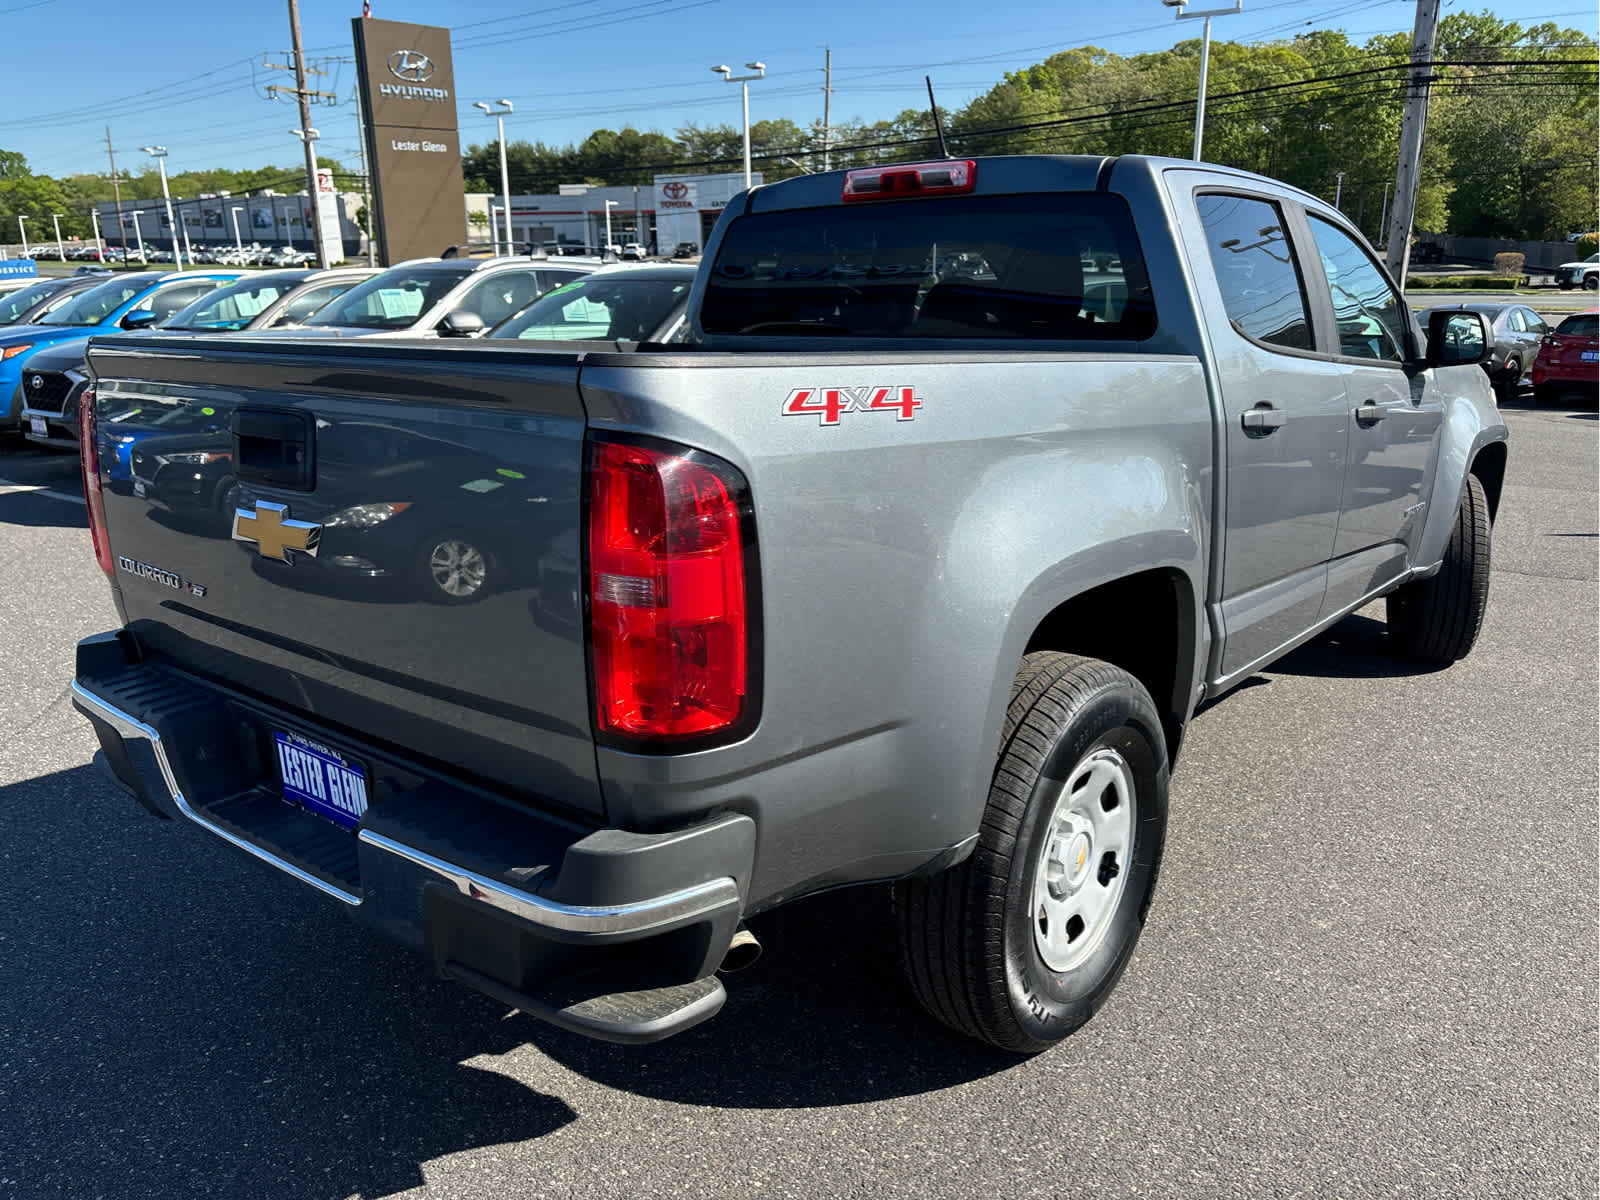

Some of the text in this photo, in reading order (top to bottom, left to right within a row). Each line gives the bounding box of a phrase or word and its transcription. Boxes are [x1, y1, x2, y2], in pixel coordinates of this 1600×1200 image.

[379, 83, 449, 101] HYUNDAI
[391, 139, 448, 153] Lester Glenn
[660, 200, 694, 209] TOYOTA
[119, 555, 181, 589] COLORADO
[277, 742, 368, 816] LESTER GLENN
